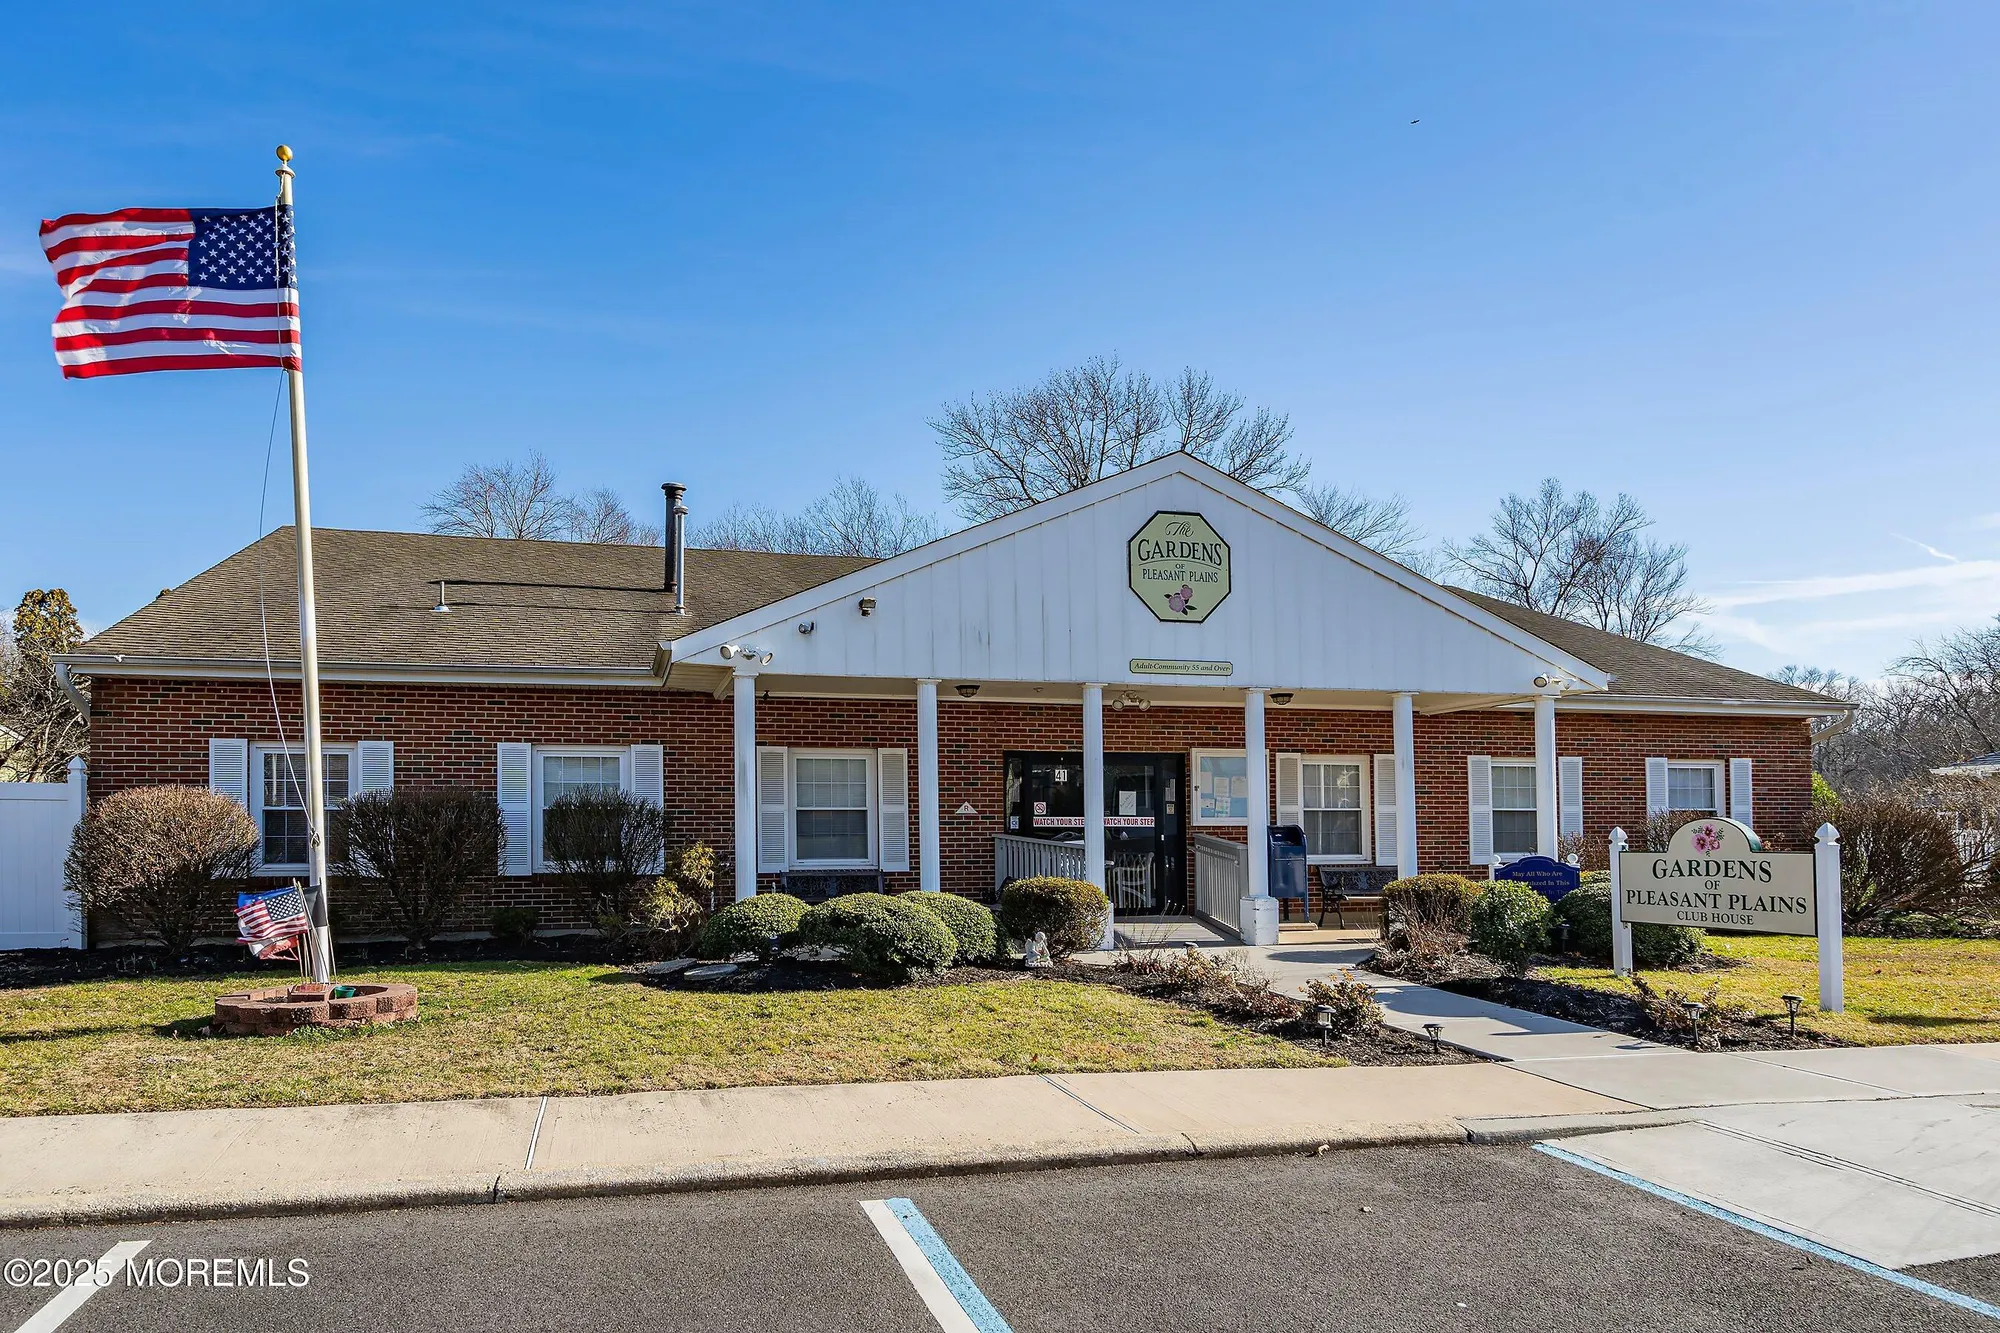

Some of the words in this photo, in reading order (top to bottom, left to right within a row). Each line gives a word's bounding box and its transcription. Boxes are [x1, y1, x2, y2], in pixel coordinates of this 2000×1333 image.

[1165, 521, 1194, 537] The
[1138, 538, 1222, 566] GARDENS
[1142, 568, 1186, 581] PLEASANT
[1189, 571, 1218, 583] PLAINS
[1055, 770, 1067, 781] 41
[1033, 818, 1054, 826] WATCH
[1056, 818, 1072, 826] YOUR
[1073, 818, 1085, 826] STE
[1123, 818, 1139, 826] YOUR
[1140, 818, 1154, 826] STEP
[1512, 871, 1525, 879] May
[1652, 858, 1772, 883] GARDENS
[1704, 880, 1720, 890] OF
[1626, 889, 1722, 909] PLEASANT
[1728, 893, 1807, 914] PLAINS
[1676, 910, 1708, 922] CLUB
[1712, 912, 1754, 925] HOUSE
